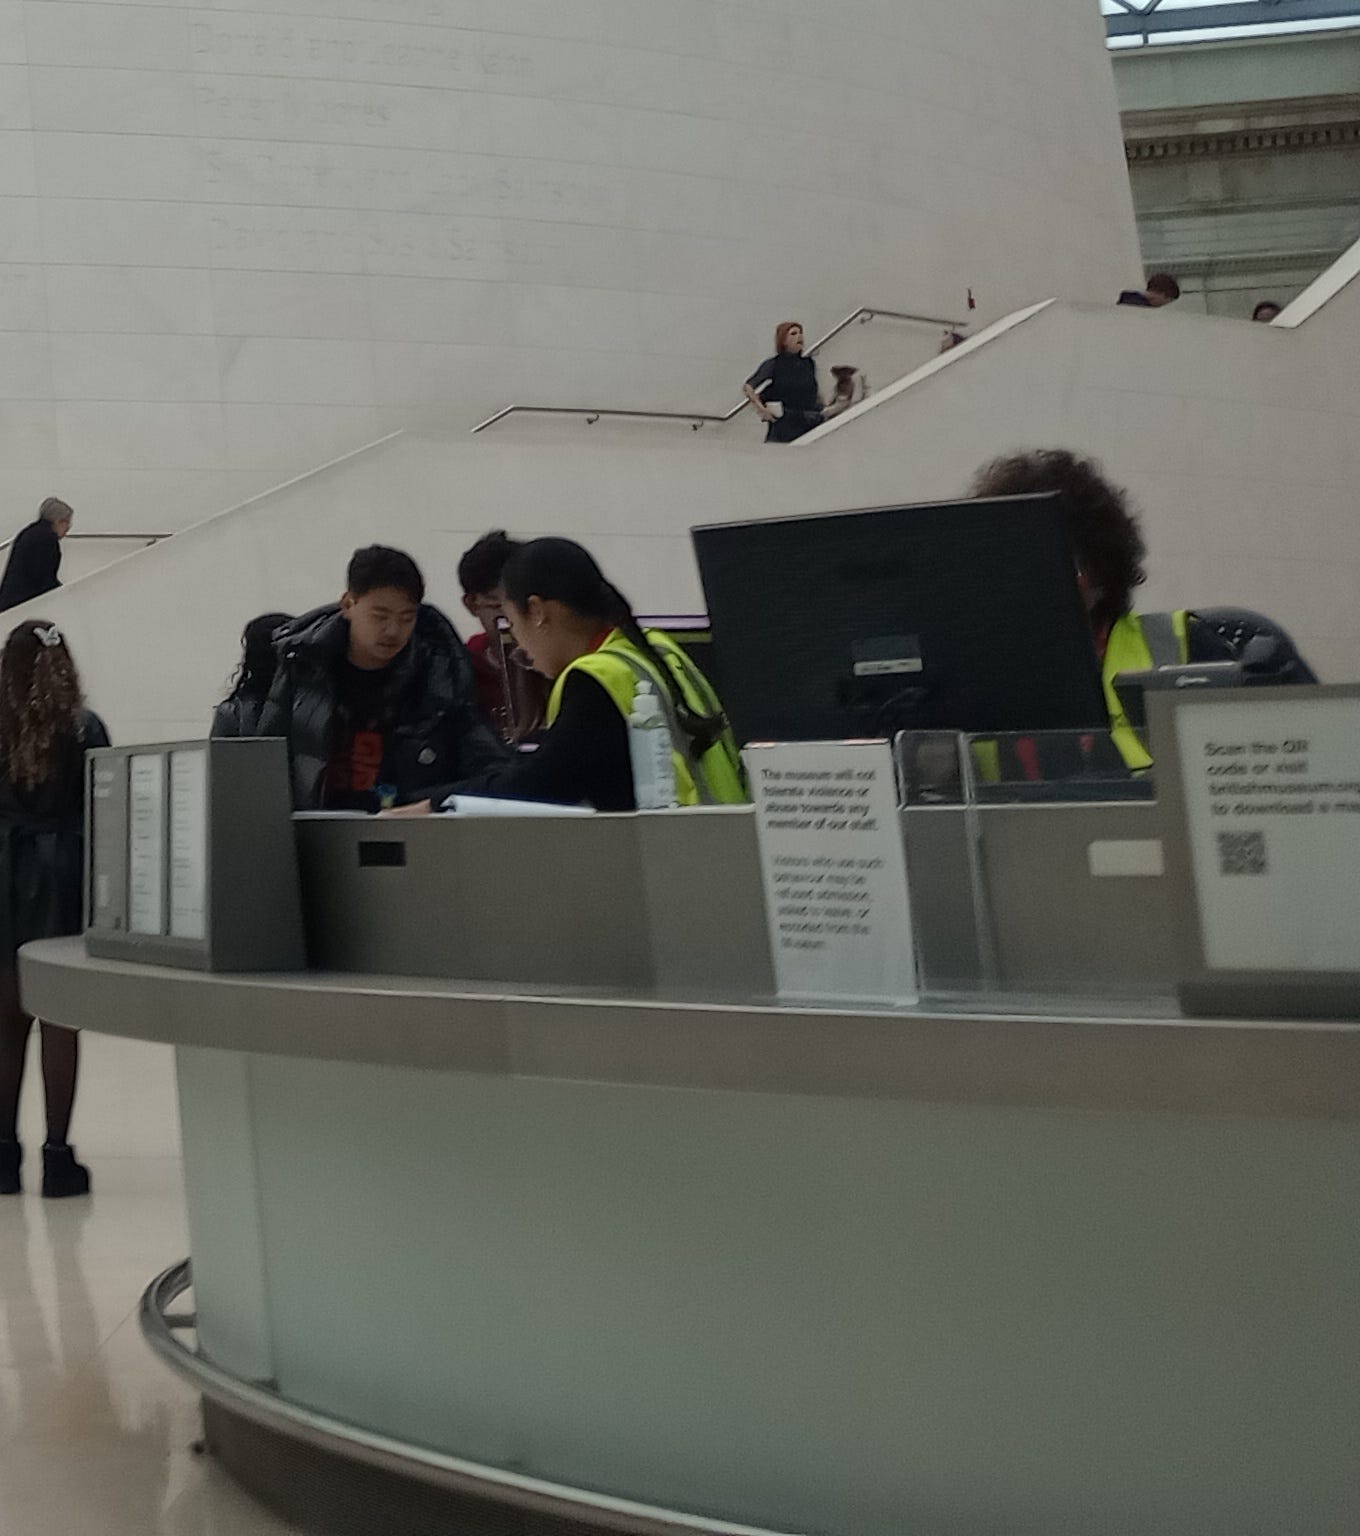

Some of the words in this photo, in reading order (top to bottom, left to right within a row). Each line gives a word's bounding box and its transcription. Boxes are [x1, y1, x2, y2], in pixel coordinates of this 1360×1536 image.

[1204, 742, 1246, 757] Scan
[1250, 742, 1279, 755] the
[1282, 740, 1310, 754] QR
[761, 769, 782, 779] The
[785, 771, 832, 780] museum
[1207, 762, 1248, 776] code
[1251, 764, 1270, 776] or
[1275, 761, 1309, 774] visit
[1211, 803, 1230, 816] to
[1232, 800, 1314, 815] download
[1335, 802, 1360, 813] ma
[767, 818, 812, 828] member
